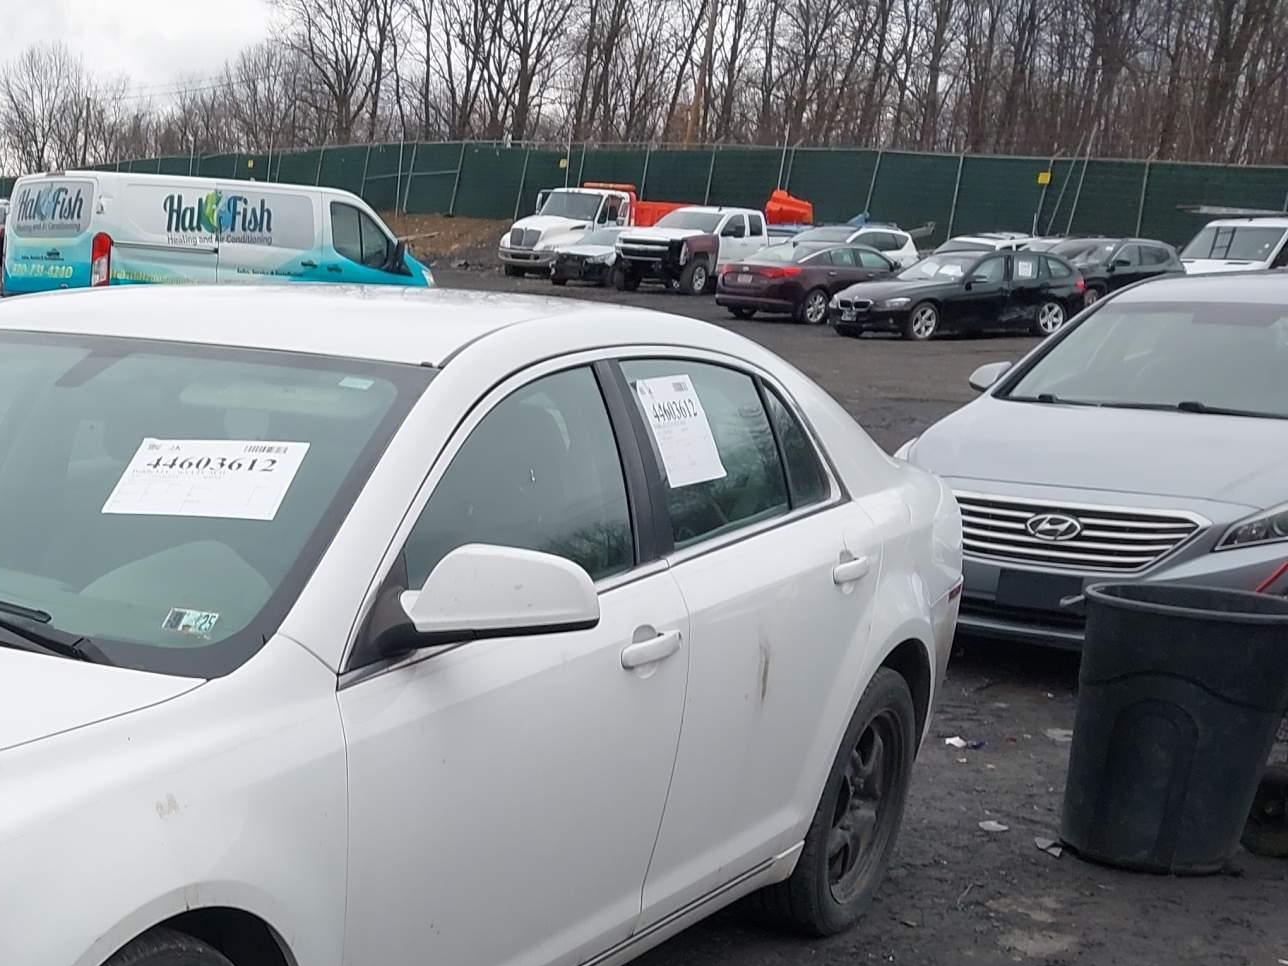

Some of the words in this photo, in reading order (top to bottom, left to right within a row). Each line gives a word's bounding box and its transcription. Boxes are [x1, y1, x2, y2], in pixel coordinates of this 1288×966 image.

[227, 195, 272, 233] Fish
[167, 233, 198, 246] Heating
[199, 235, 213, 244] and
[226, 234, 273, 246] Conditioning
[652, 398, 698, 422] 44603612
[146, 455, 278, 472] 44603612
